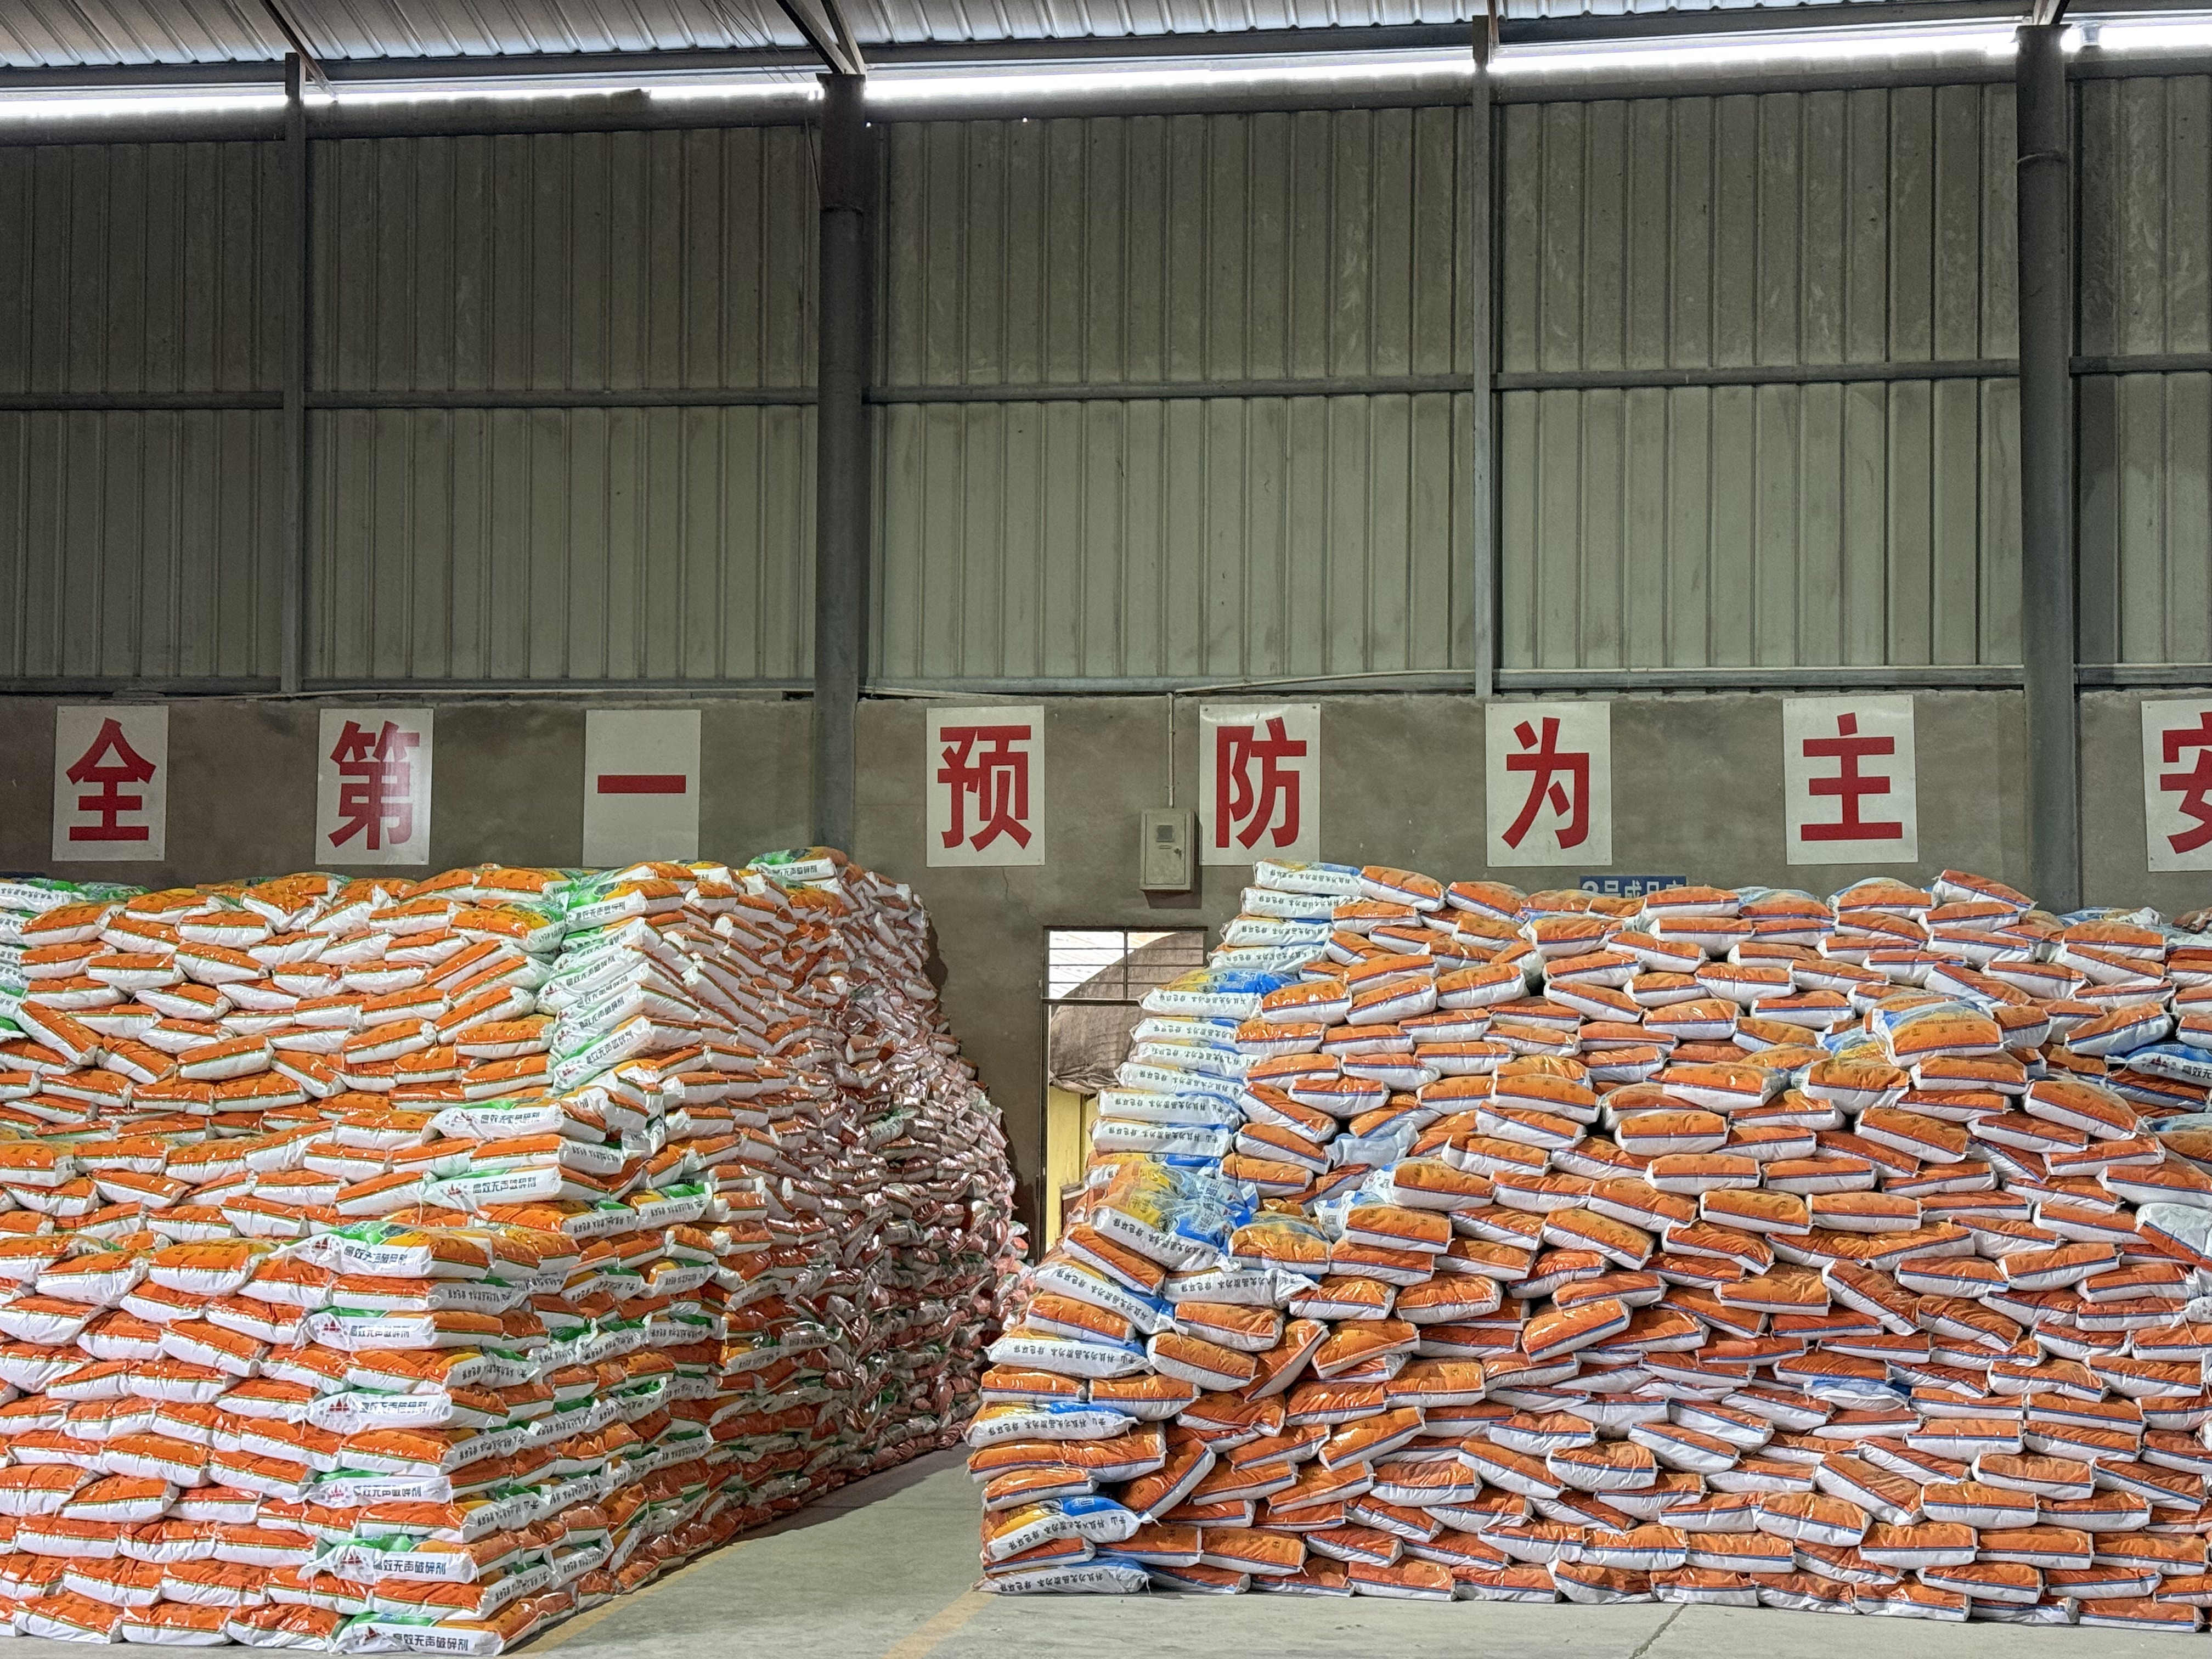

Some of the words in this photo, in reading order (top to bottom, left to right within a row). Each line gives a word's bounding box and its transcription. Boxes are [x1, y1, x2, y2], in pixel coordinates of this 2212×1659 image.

[65, 718, 156, 842] 全
[328, 720, 420, 850] 第
[599, 774, 685, 794] 一
[938, 725, 1032, 851] 预
[1217, 717, 1307, 849] 防
[1501, 717, 1590, 850] 为
[1801, 713, 1903, 842] 主
[473, 1176, 536, 1194] 高效无声破碎剂
[1113, 1218, 1143, 1238] 绿色环保
[1181, 1282, 1211, 1293] 绿色环保
[1091, 1285, 1149, 1321] 科技为先品质为本
[1013, 1345, 1045, 1355] 绿色环保
[1050, 1347, 1115, 1363] 科技为先品质为本
[988, 1423, 1019, 1436] 绿色环保
[1008, 1530, 1040, 1550] 绿色环保
[373, 1559, 447, 1575] 高效无声破碎剂
[1000, 1582, 1031, 1592] 绿色环保
[1037, 1573, 1103, 1587] 科技为先品质为本
[393, 1633, 469, 1651] 高效无声破碎剂
